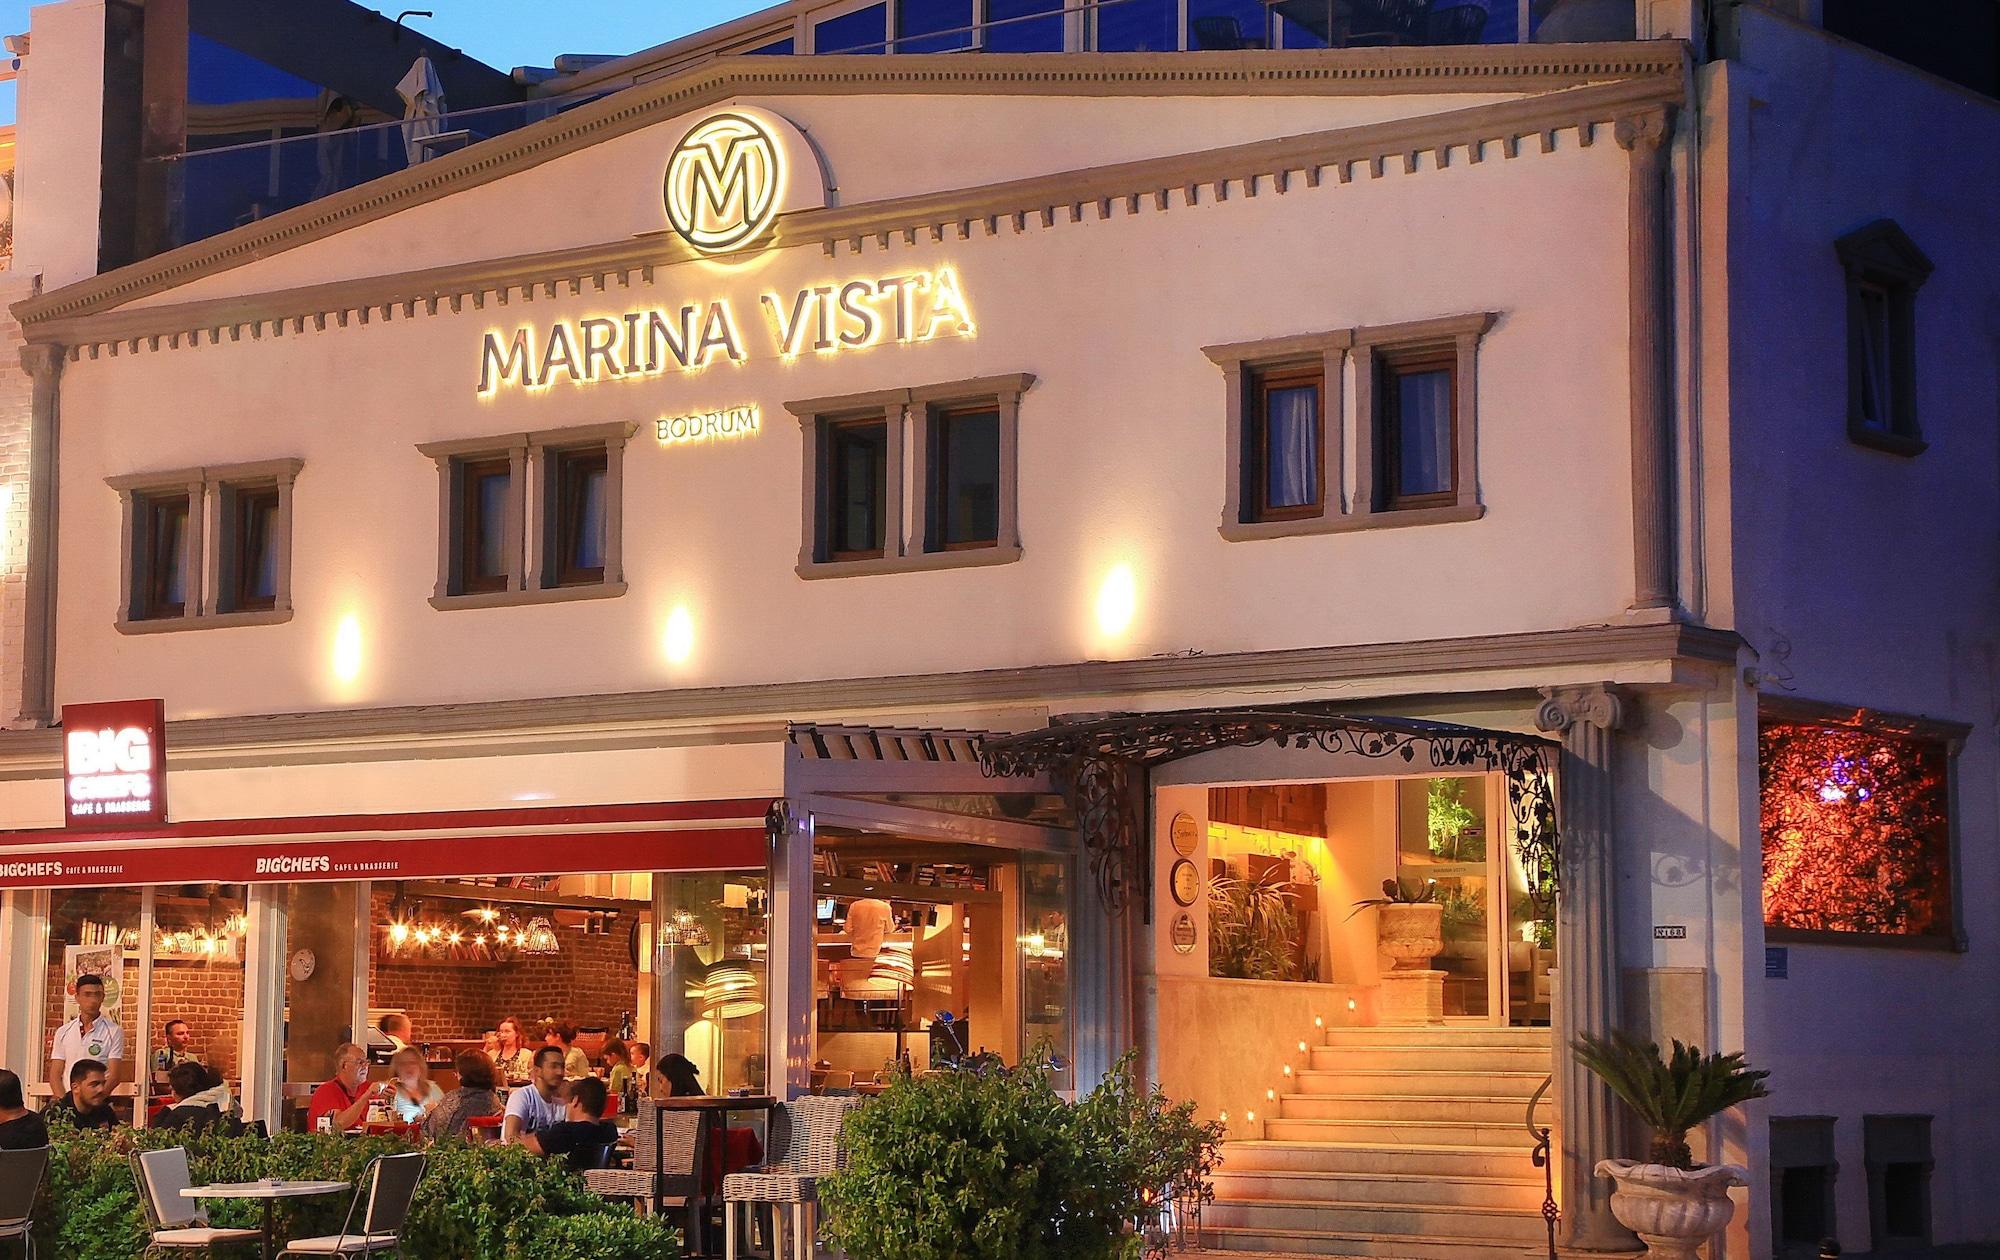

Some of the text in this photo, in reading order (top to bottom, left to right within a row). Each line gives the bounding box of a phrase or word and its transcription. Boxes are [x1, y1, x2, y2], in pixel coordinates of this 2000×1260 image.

[476, 266, 976, 394] MARINA VISTA
[656, 407, 759, 442] BODRUM
[68, 727, 150, 775] BIG
[69, 773, 151, 800] CFS
[72, 803, 93, 815] CAFE
[95, 802, 103, 814] &
[65, 866, 80, 875] CAFE
[88, 865, 123, 874] BRASSERIE
[334, 863, 352, 871] CAFE
[354, 862, 359, 871] &
[360, 861, 399, 870] BRASSERIE
